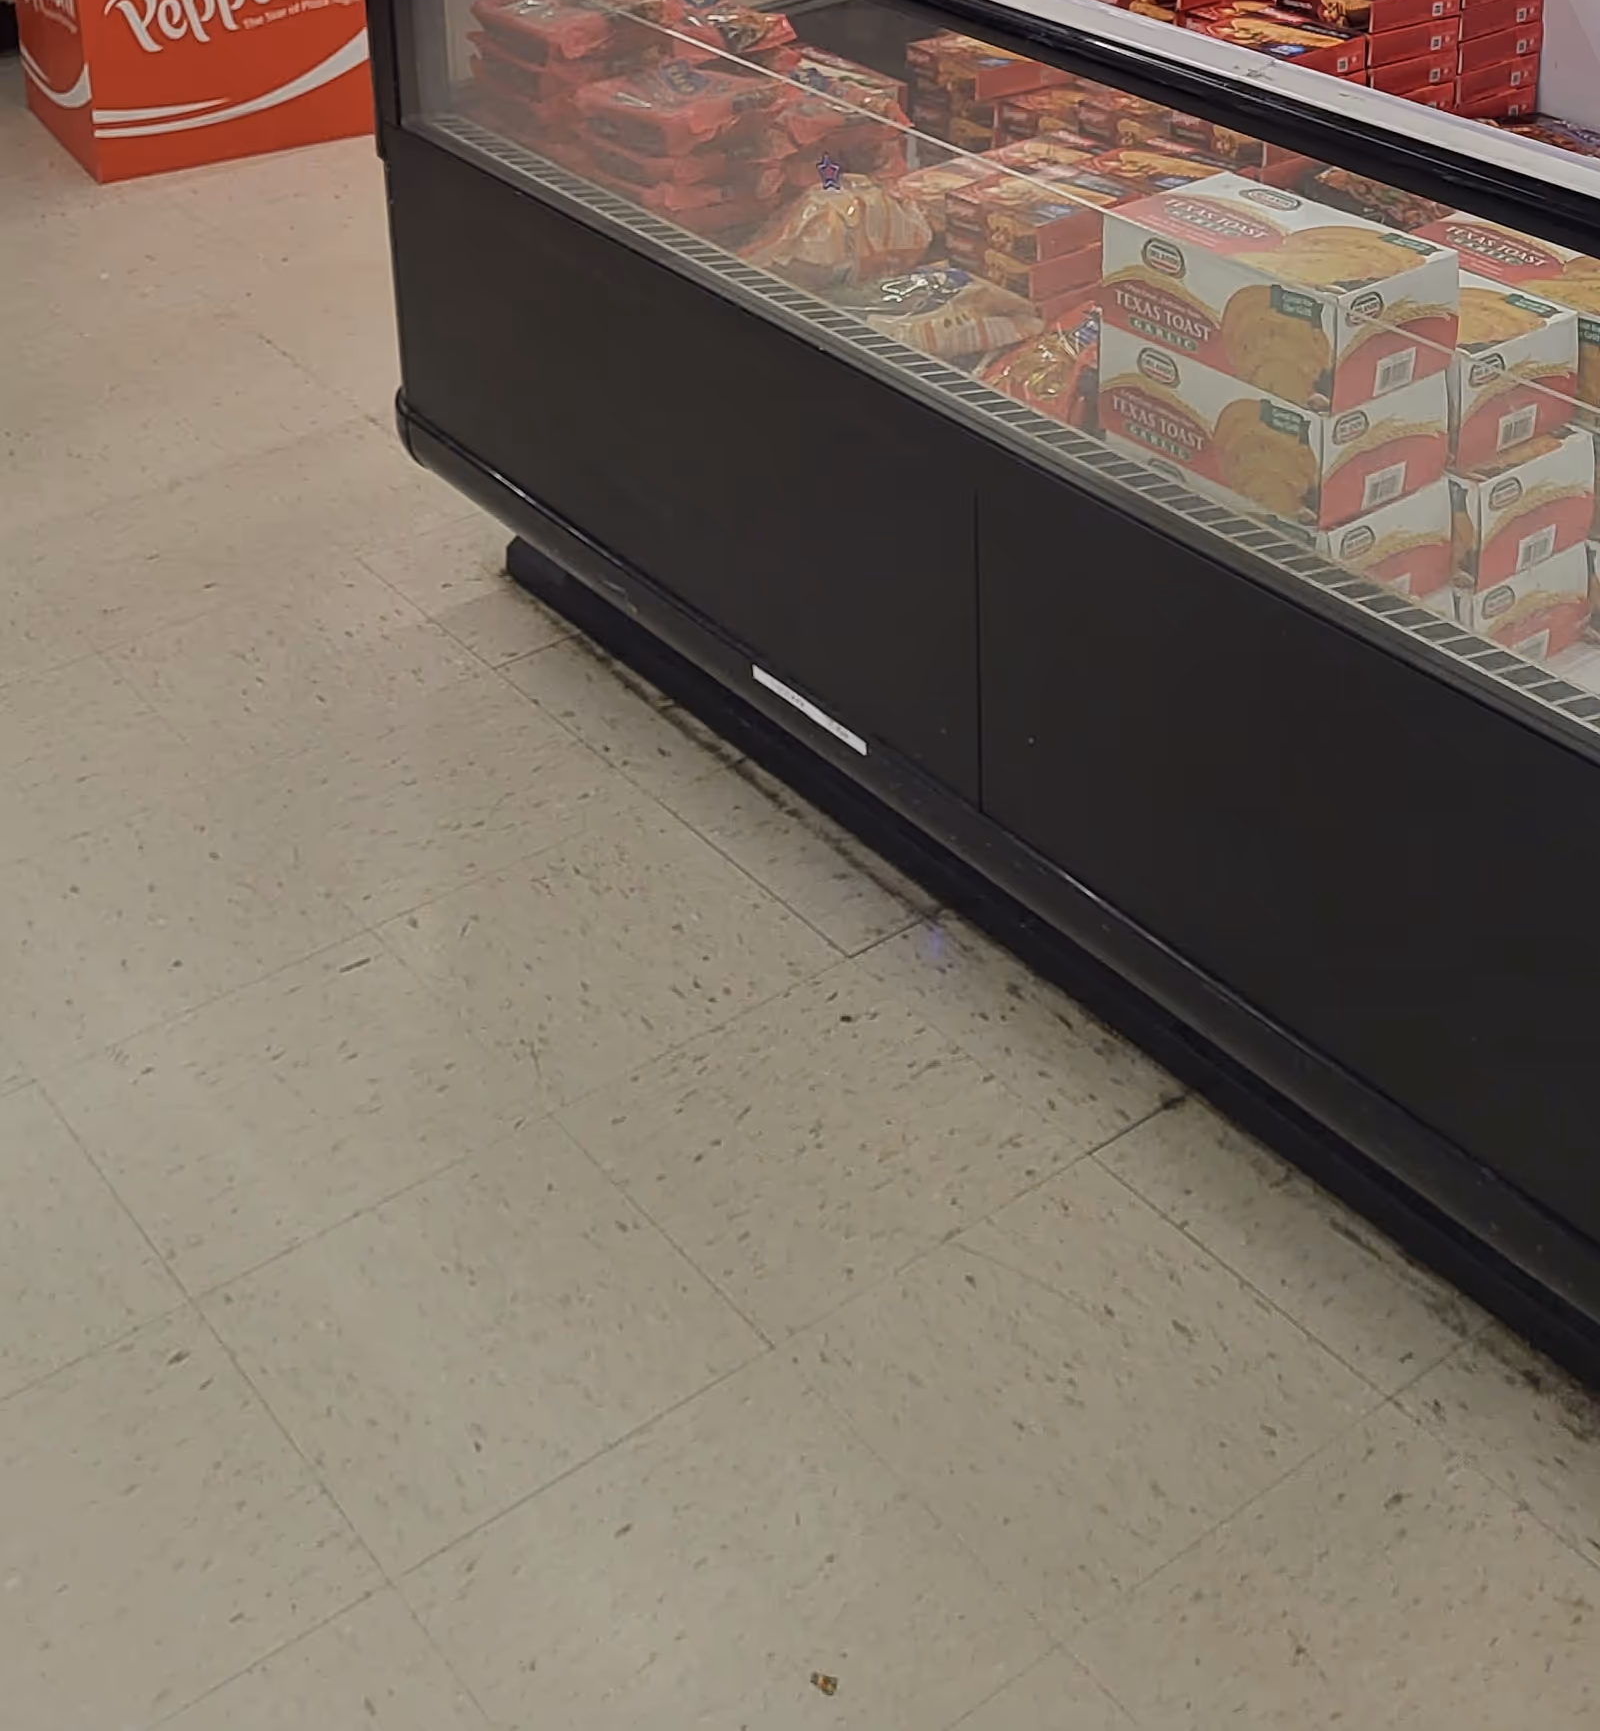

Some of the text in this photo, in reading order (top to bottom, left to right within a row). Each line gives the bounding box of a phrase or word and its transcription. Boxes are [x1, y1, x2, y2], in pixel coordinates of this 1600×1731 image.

[1165, 198, 1269, 239] TEXAS TOAST
[1445, 225, 1548, 267] TEXAS TOAST
[1114, 288, 1161, 321] TEXAS
[1163, 309, 1212, 342] TOAST
[1111, 394, 1157, 430] TEXAS
[1160, 421, 1204, 451] TOAST
